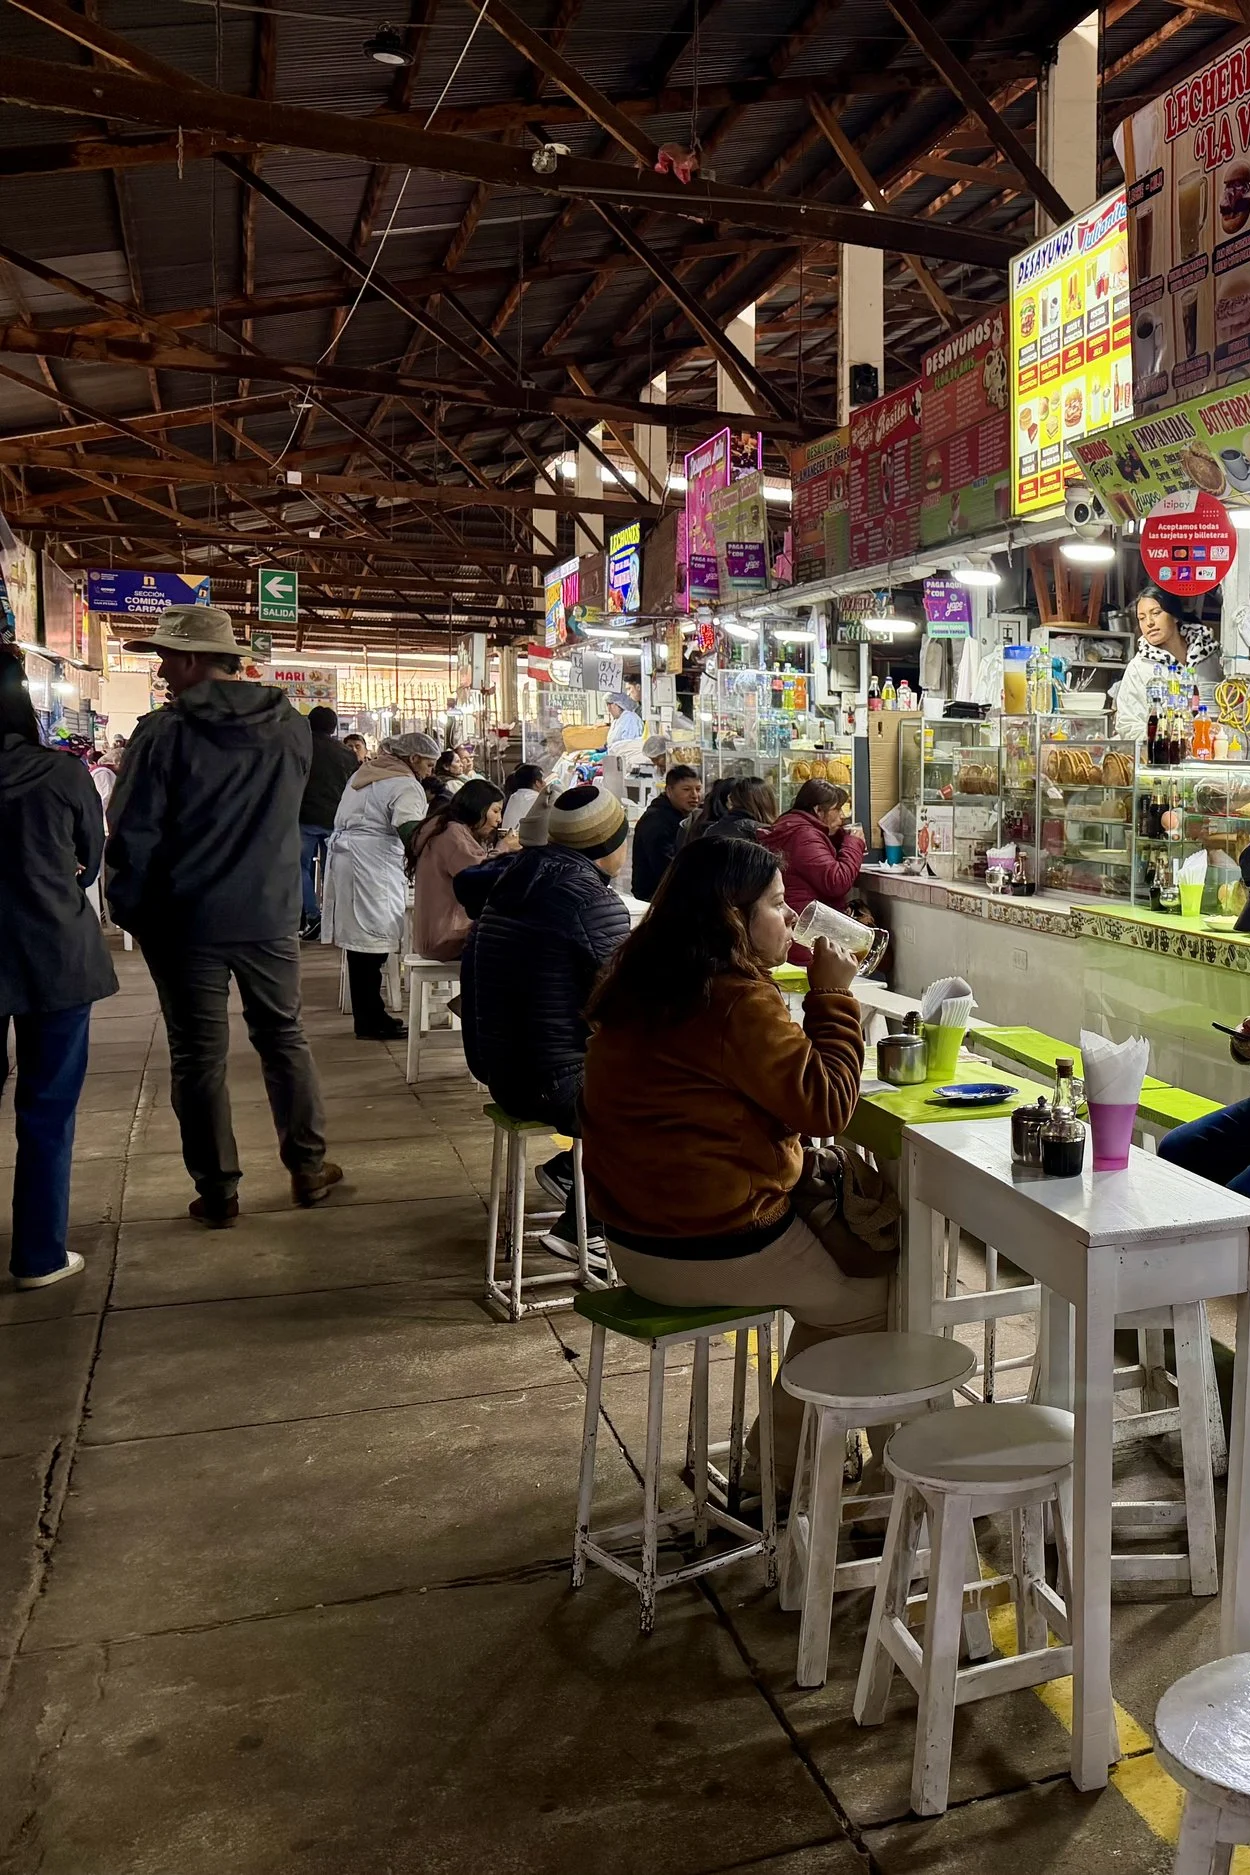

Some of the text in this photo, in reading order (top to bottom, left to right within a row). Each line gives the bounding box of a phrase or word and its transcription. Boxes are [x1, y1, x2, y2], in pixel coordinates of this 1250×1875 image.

[1017, 225, 1076, 286] DESAYUNOS
[926, 318, 991, 377] DESAYUNOS
[1131, 412, 1198, 453] EMPANADAS
[1077, 439, 1114, 463] BEBIDAS
[1130, 486, 1161, 514] Jugos
[1164, 499, 1190, 510] izipay
[1158, 523, 1198, 532] Aceptamos
[609, 522, 640, 556] LECHONES
[1160, 532, 1188, 541] tarjetas
[1194, 531, 1229, 539] billeteras
[1147, 549, 1169, 558] VISA
[134, 590, 165, 598] SECCIÓN
[125, 597, 172, 606] COMIDAS
[263, 608, 295, 618] SALIDA
[944, 601, 964, 617] yape
[275, 671, 305, 681] MARI
